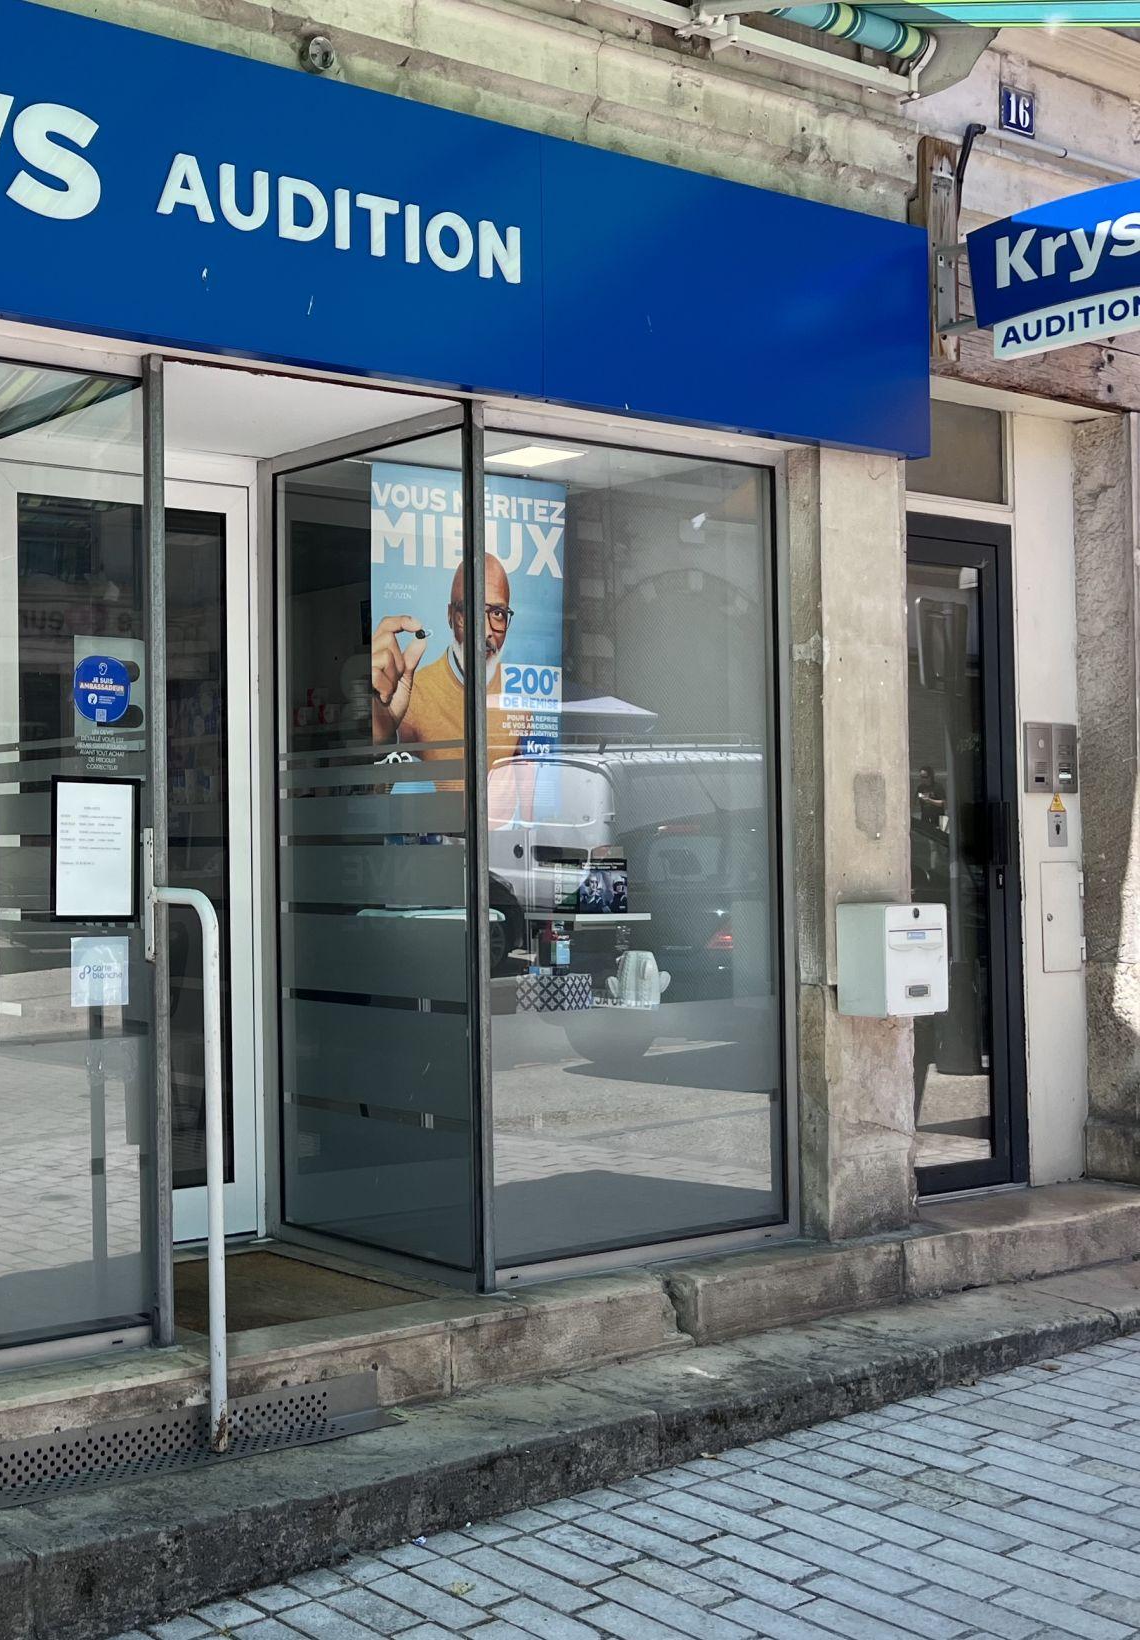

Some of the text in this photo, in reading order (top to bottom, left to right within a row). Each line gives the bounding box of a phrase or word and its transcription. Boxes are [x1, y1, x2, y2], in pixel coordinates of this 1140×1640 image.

[1008, 93, 1031, 128] 16
[156, 152, 522, 284] AUDITION
[995, 211, 1140, 290] Krys
[372, 481, 446, 513] VOUS
[371, 508, 564, 579] MIEUX
[503, 697, 559, 710] DE REMISE
[527, 740, 550, 756] Krys
